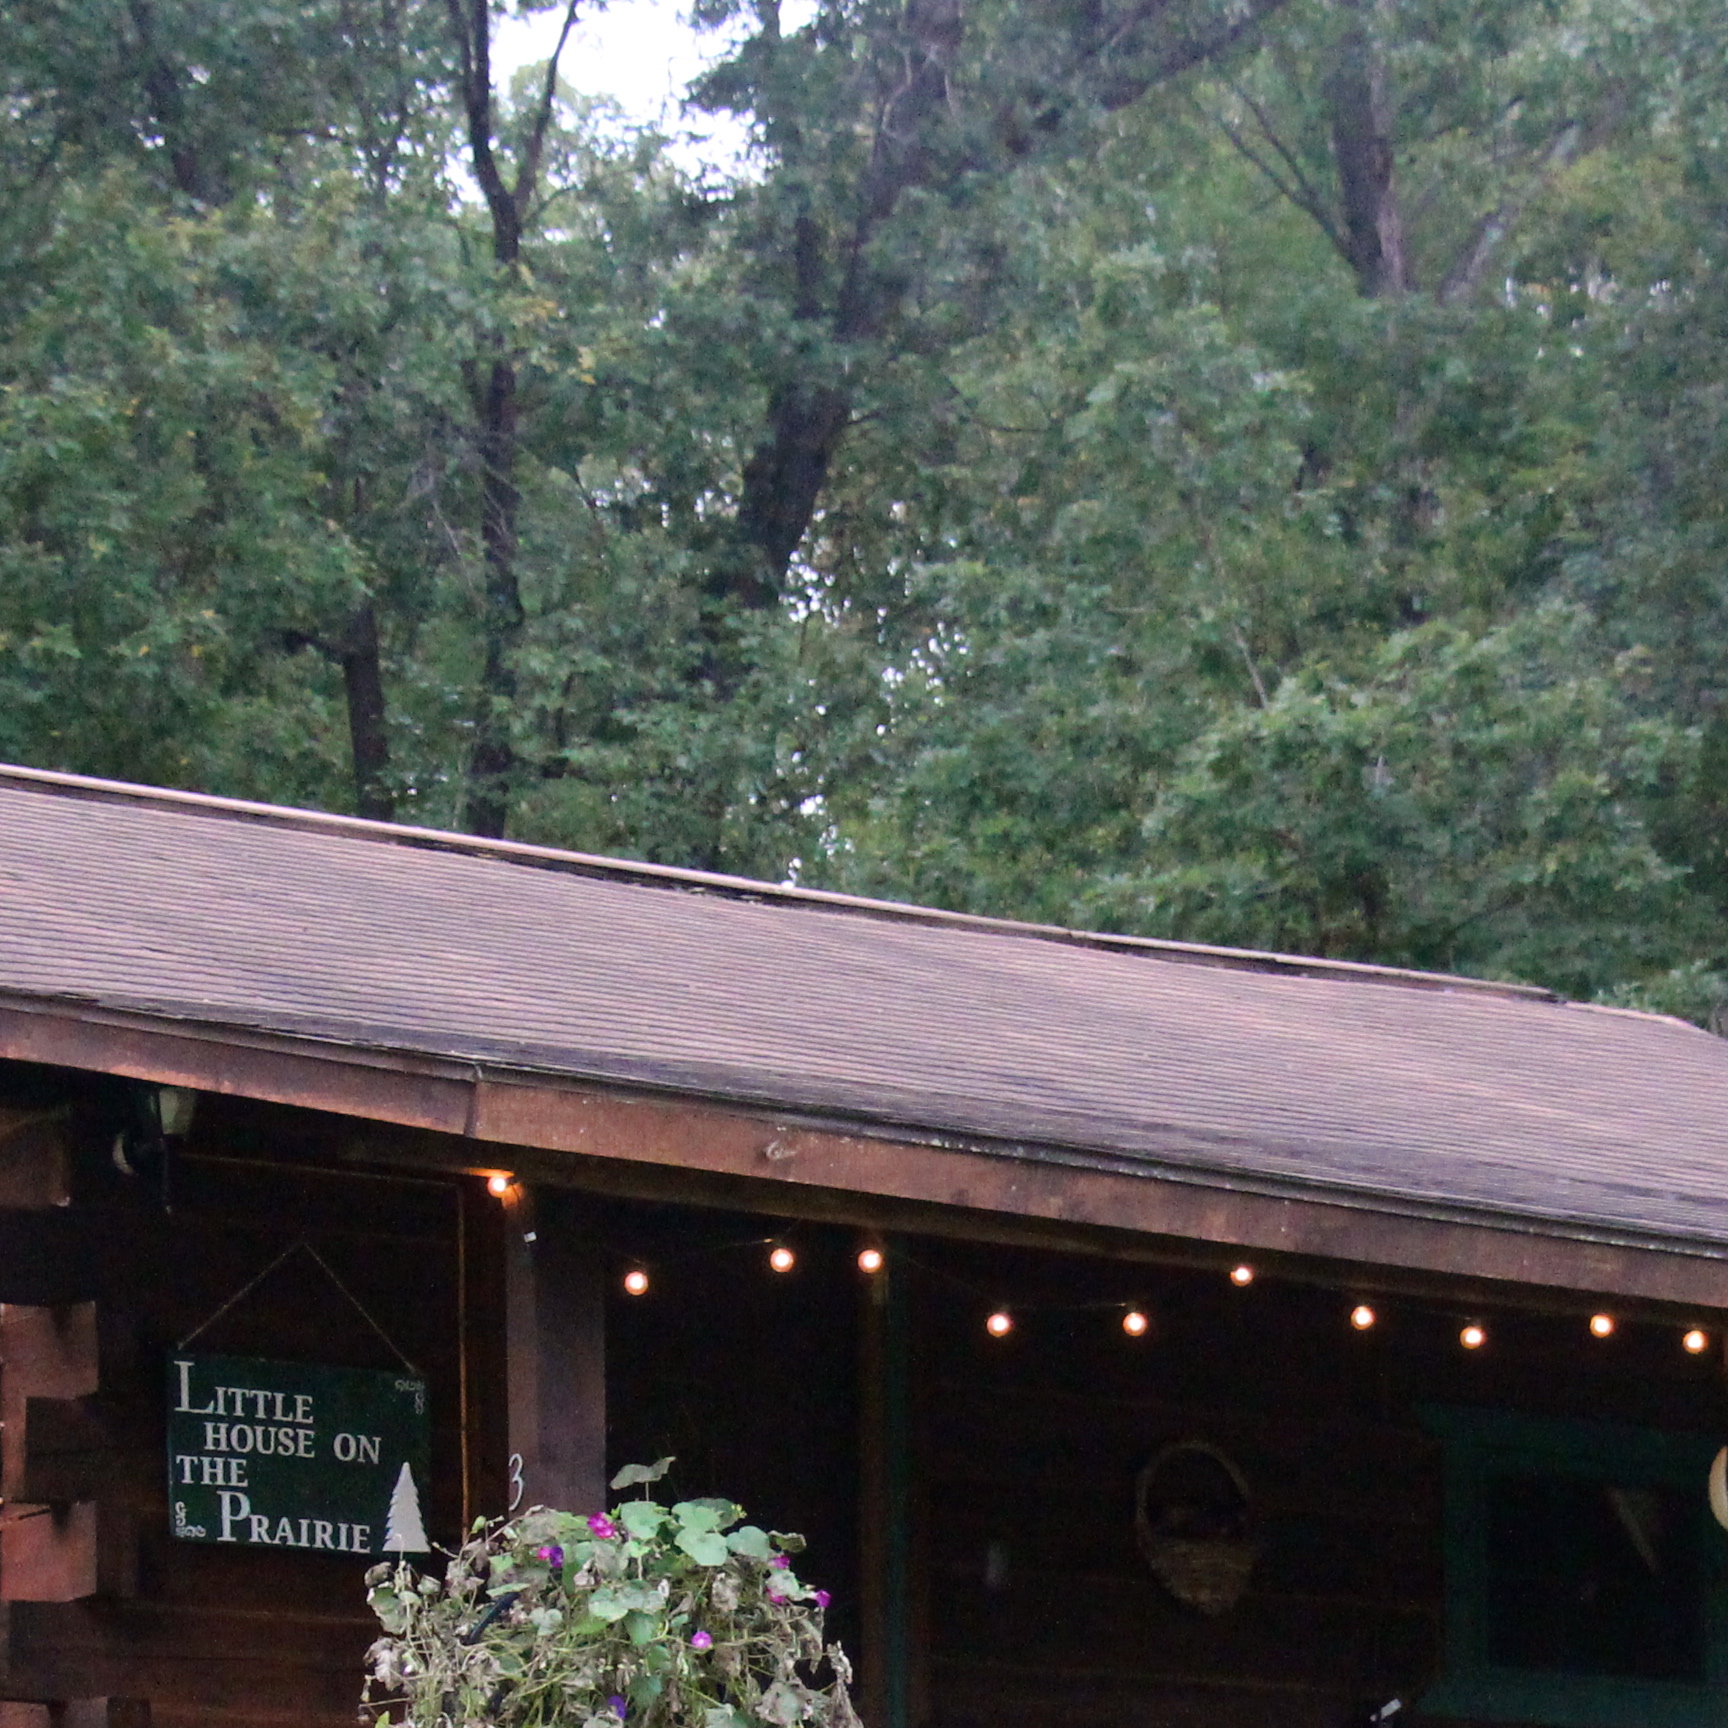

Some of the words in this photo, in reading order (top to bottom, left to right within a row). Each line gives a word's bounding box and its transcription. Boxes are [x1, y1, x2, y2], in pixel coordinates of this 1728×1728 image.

[174, 1361, 314, 1424] LITTLE
[204, 1421, 315, 1457] HOUSE
[333, 1433, 382, 1464] ON
[176, 1455, 248, 1487] THE
[217, 1490, 371, 1553] PRAIRIE
